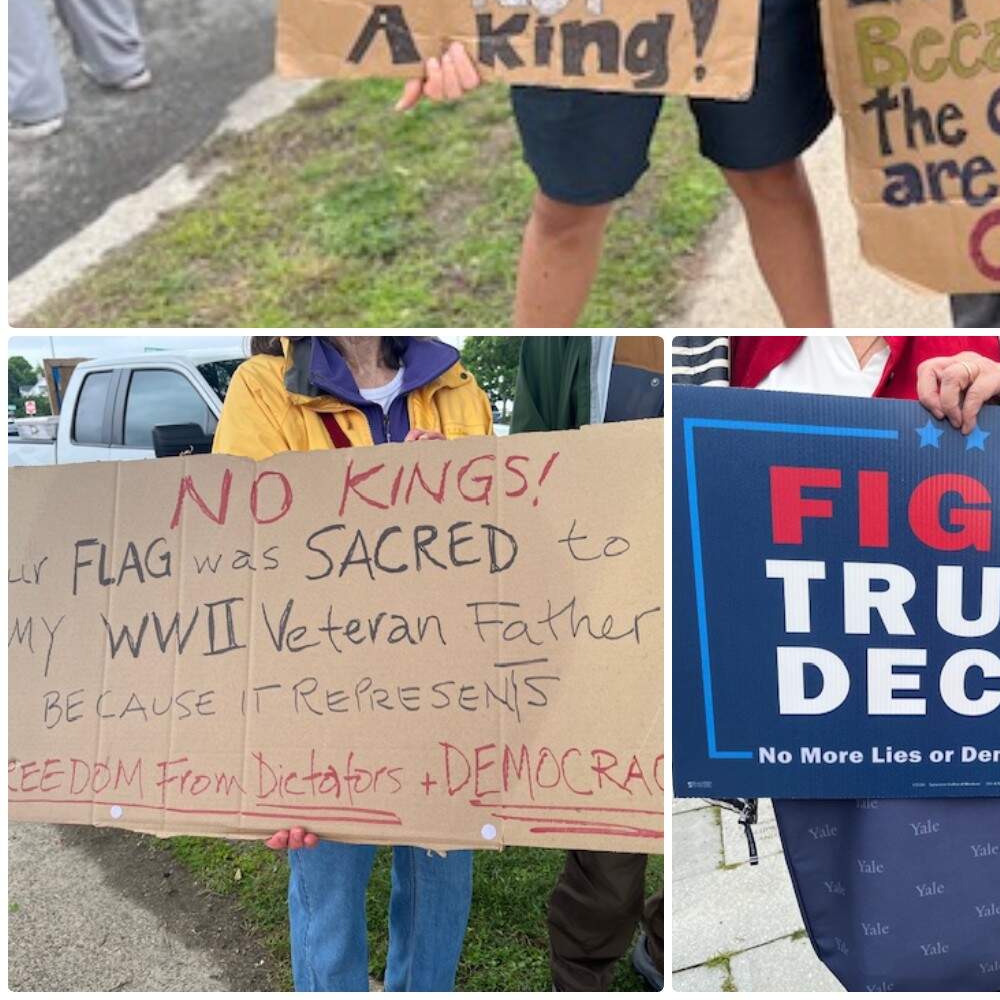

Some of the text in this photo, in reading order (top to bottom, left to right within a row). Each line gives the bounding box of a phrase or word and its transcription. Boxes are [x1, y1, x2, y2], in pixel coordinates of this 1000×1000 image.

[345, 4, 422, 65] A
[880, 152, 999, 207] are
[170, 451, 560, 529] NO KINGS!
[72, 537, 171, 596] FLAG
[194, 544, 279, 576] was
[305, 521, 518, 580] SACRED
[558, 519, 630, 561] to
[8, 615, 66, 677] MY
[262, 598, 445, 653] Veteran
[465, 597, 661, 647] Father
[43, 688, 216, 729] BECAUSE
[240, 685, 281, 718] IT
[758, 747, 792, 763] No
[801, 747, 863, 763] More
[871, 746, 922, 763] Lies
[929, 750, 954, 763] or
[156, 757, 247, 809] From
[251, 749, 403, 806] Dictators
[909, 820, 940, 836] Yale
[970, 843, 1000, 858] Yale
[857, 859, 884, 874] Yale
[916, 881, 945, 897] Yale
[861, 922, 890, 937] Yale
[920, 942, 949, 957] Yale
